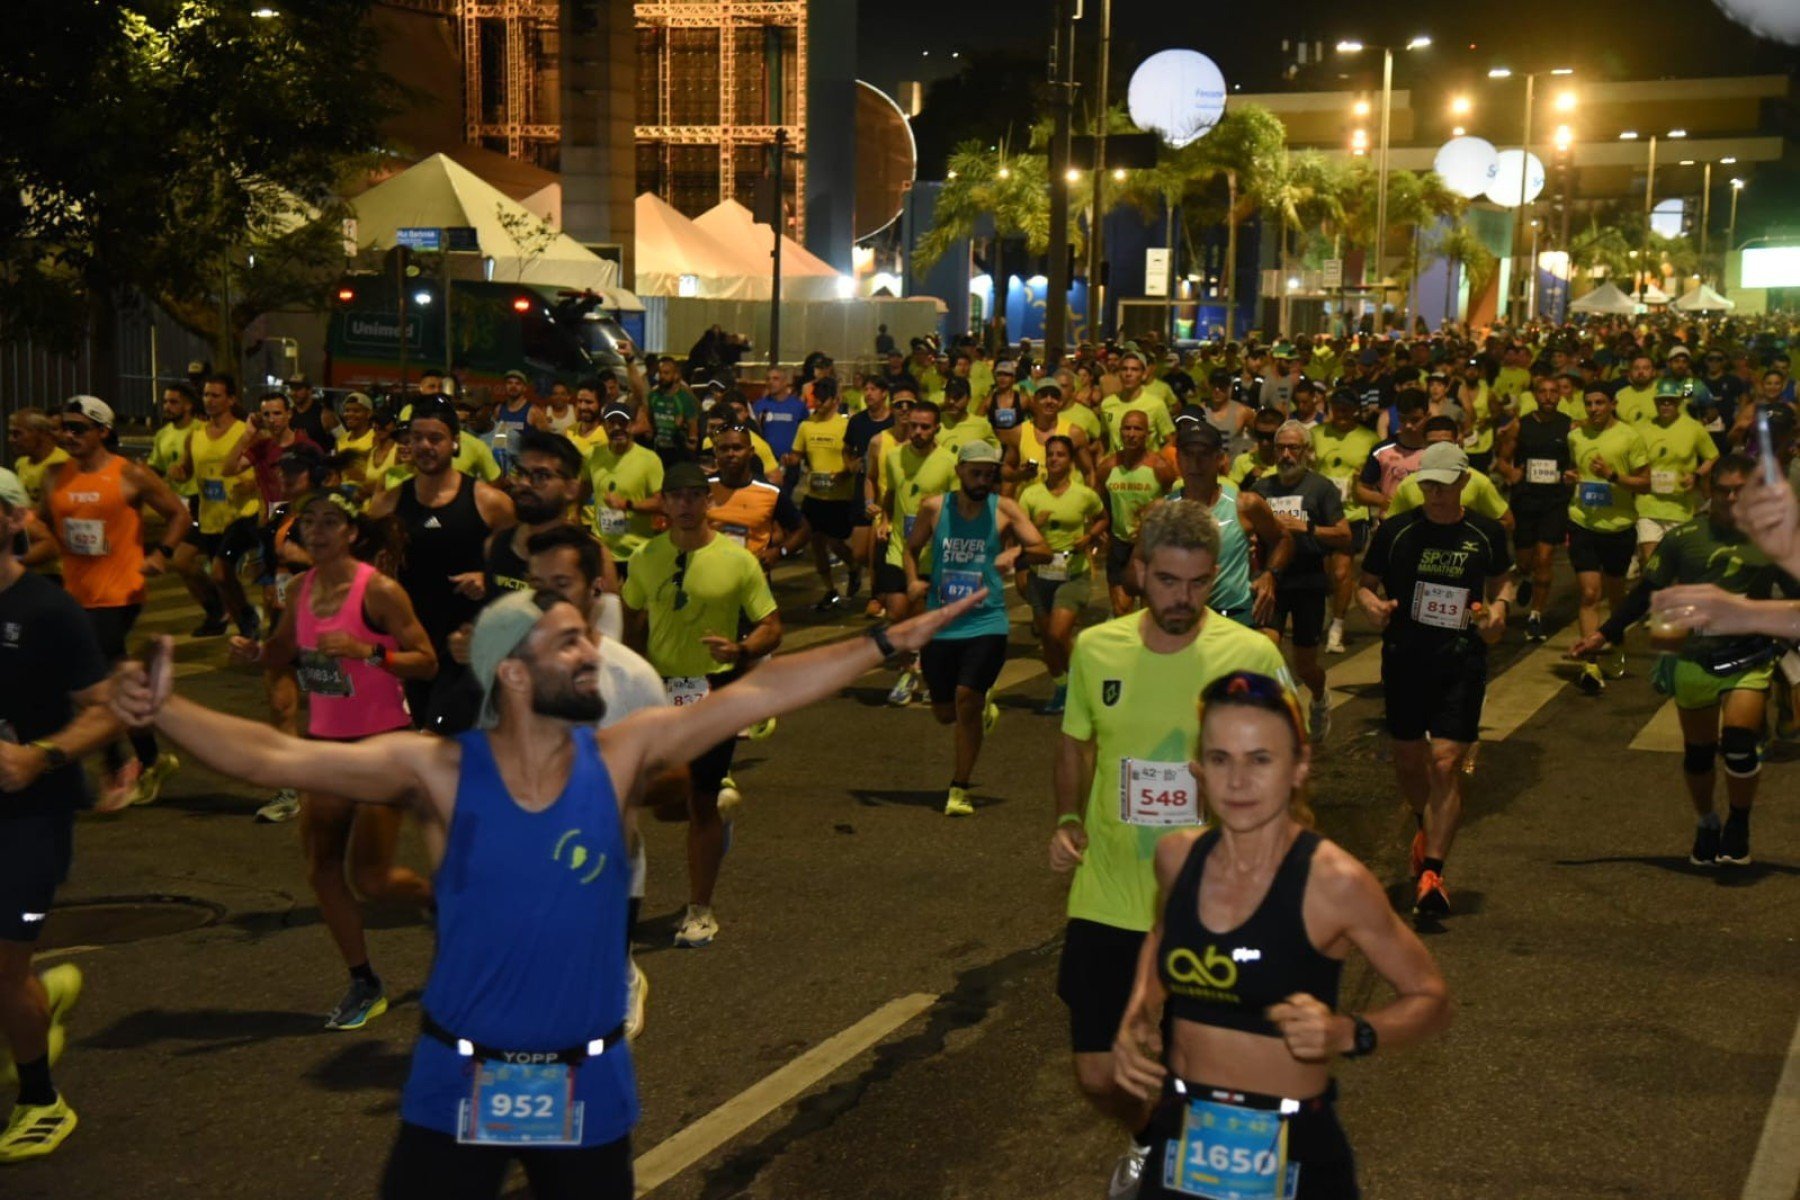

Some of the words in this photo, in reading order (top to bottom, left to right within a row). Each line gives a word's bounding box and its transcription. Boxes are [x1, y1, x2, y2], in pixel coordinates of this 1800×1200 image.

[942, 537, 985, 551] NEVER
[942, 550, 973, 563] STOP
[1417, 564, 1465, 577] MARATHON
[1428, 601, 1458, 616] 813
[1141, 788, 1187, 806] 548
[504, 1052, 559, 1063] YOPP
[491, 1094, 553, 1118] 952
[1190, 1140, 1277, 1176] 1650
